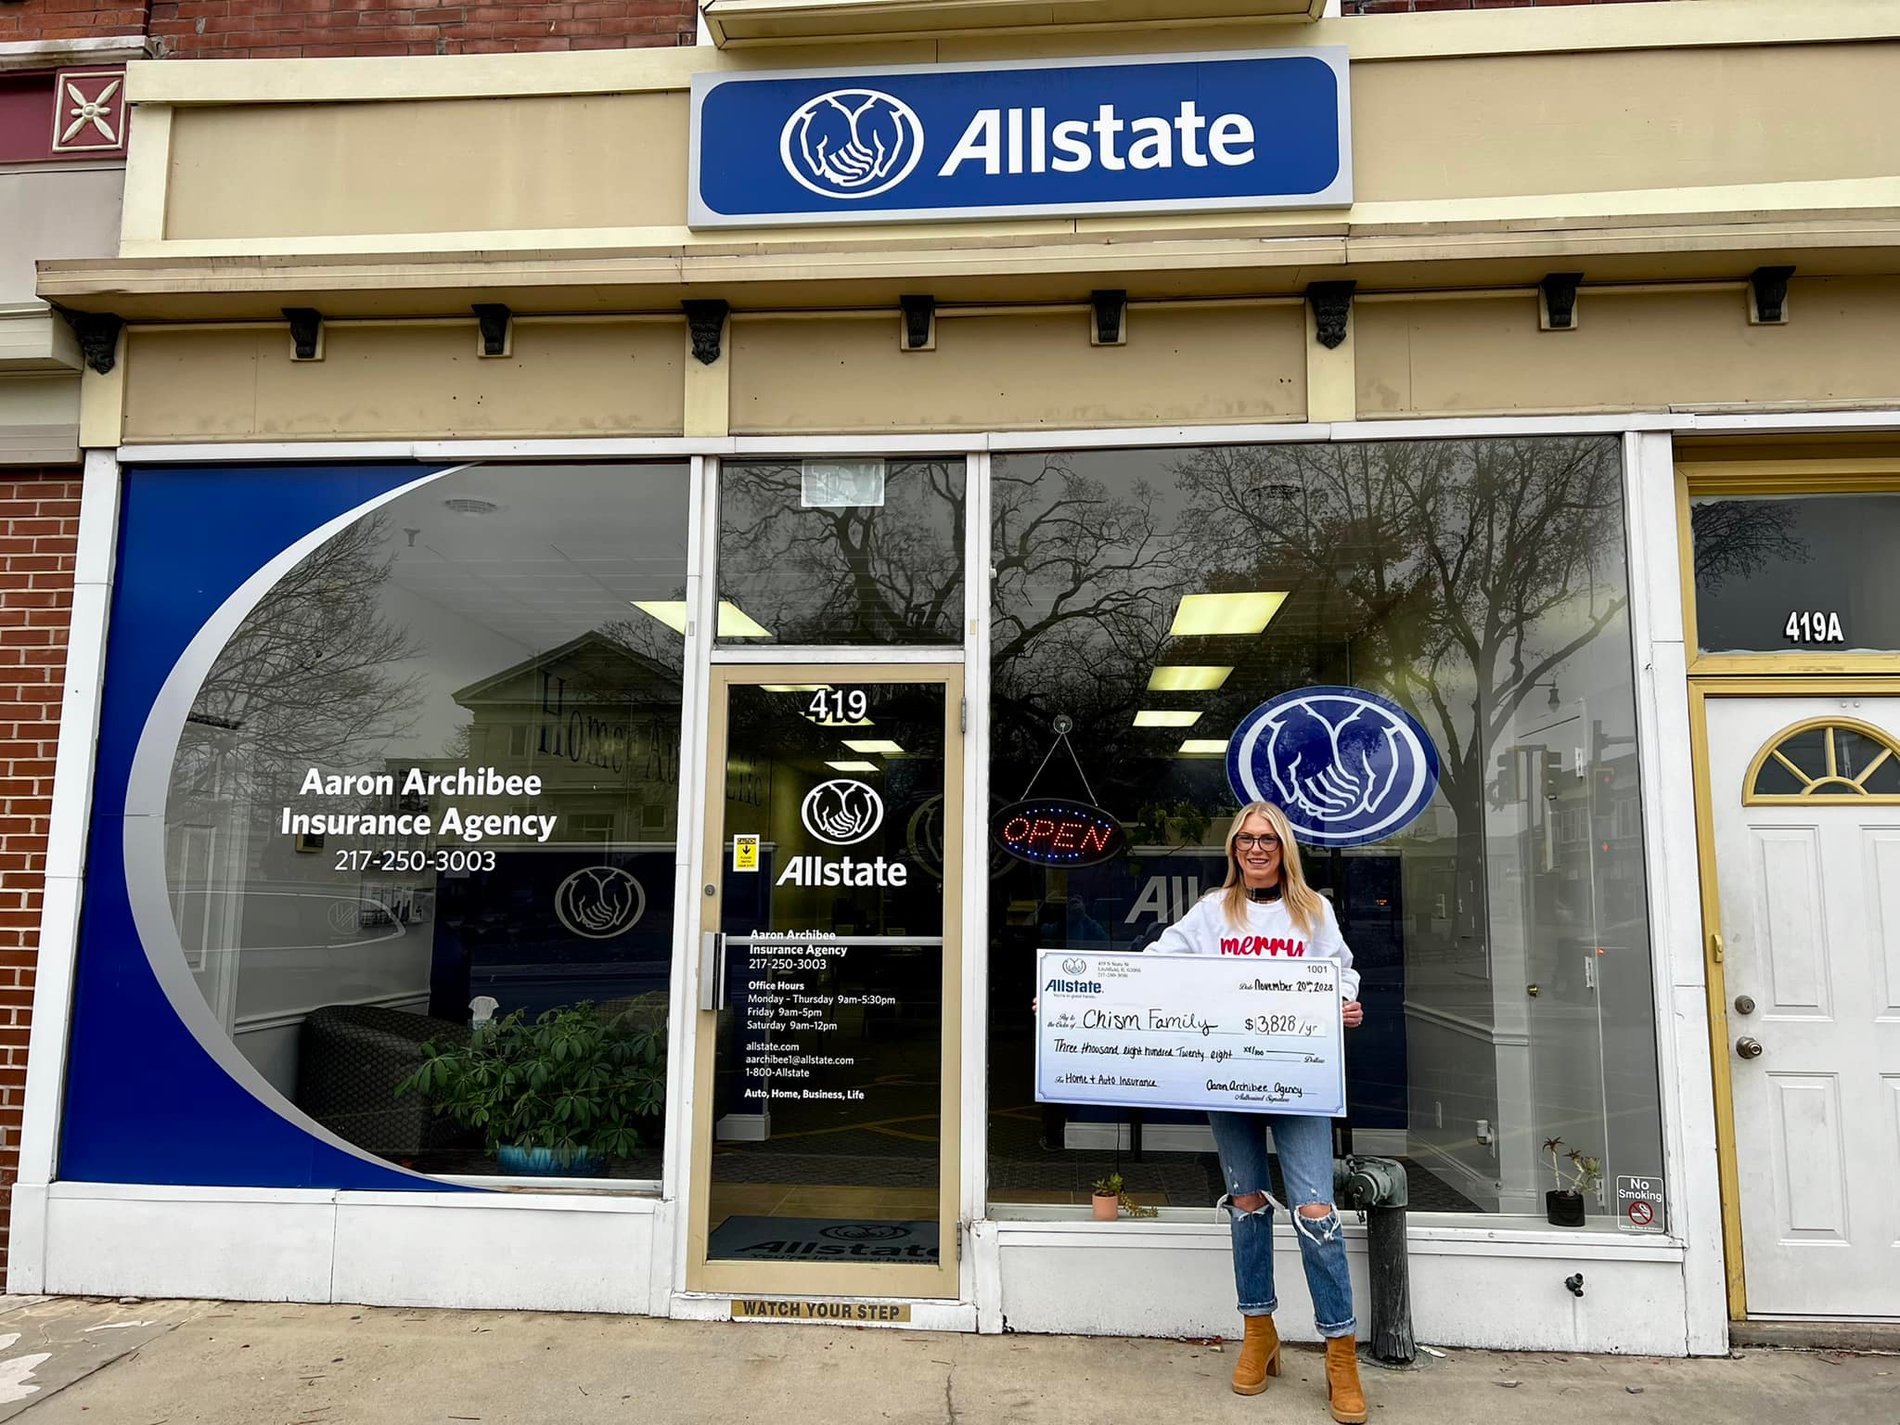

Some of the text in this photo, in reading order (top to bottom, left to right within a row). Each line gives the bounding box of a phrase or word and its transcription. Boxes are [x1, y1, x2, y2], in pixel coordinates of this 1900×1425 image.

[937, 100, 1255, 177] Allstate
[1785, 611, 1845, 643] 419A
[808, 690, 867, 719] 419
[300, 766, 542, 796] Aaron Archibee
[280, 807, 557, 843] Insurance Agency
[1004, 816, 1113, 852] OPEN
[334, 850, 496, 872] 217-250-3003
[775, 856, 907, 887] Allstate
[750, 929, 836, 941] Aaron Archibee
[749, 944, 848, 958] Insurance Agency
[748, 958, 827, 970] 217-250-3003
[1307, 965, 1328, 974] 1001
[747, 980, 805, 991] Office Hours
[1254, 978, 1293, 992] November
[747, 994, 784, 1005] Monday
[792, 994, 834, 1006] Thursday
[837, 995, 896, 1006] 9am-5:30pm
[747, 1008, 823, 1019] Friday 9am-5pm
[746, 1020, 838, 1032] Saturday 9am-12pm
[1082, 1008, 1219, 1037] Chism Family
[745, 1042, 800, 1051] allstate.com
[1053, 1038, 1078, 1053] Three
[1081, 1042, 1119, 1055] thousand
[1122, 1045, 1143, 1059] eight
[1144, 1045, 1174, 1057] hundred
[1176, 1046, 1205, 1061] Twenty
[1210, 1049, 1233, 1063] eight
[745, 1055, 854, 1066] aarchibee1@allstate.com
[745, 1068, 810, 1078] 1-800-Allstate
[1065, 1073, 1089, 1085] Home
[1098, 1074, 1116, 1085] Auto
[1119, 1075, 1158, 1088] Insurance
[744, 1089, 865, 1100] Auto, Home, Business, Life
[1206, 1079, 1303, 1097] Aaron Archibee Agency
[1630, 1178, 1650, 1190] No
[1619, 1189, 1662, 1203] Smoking
[743, 1301, 900, 1321] WATCH YOUR STEP
